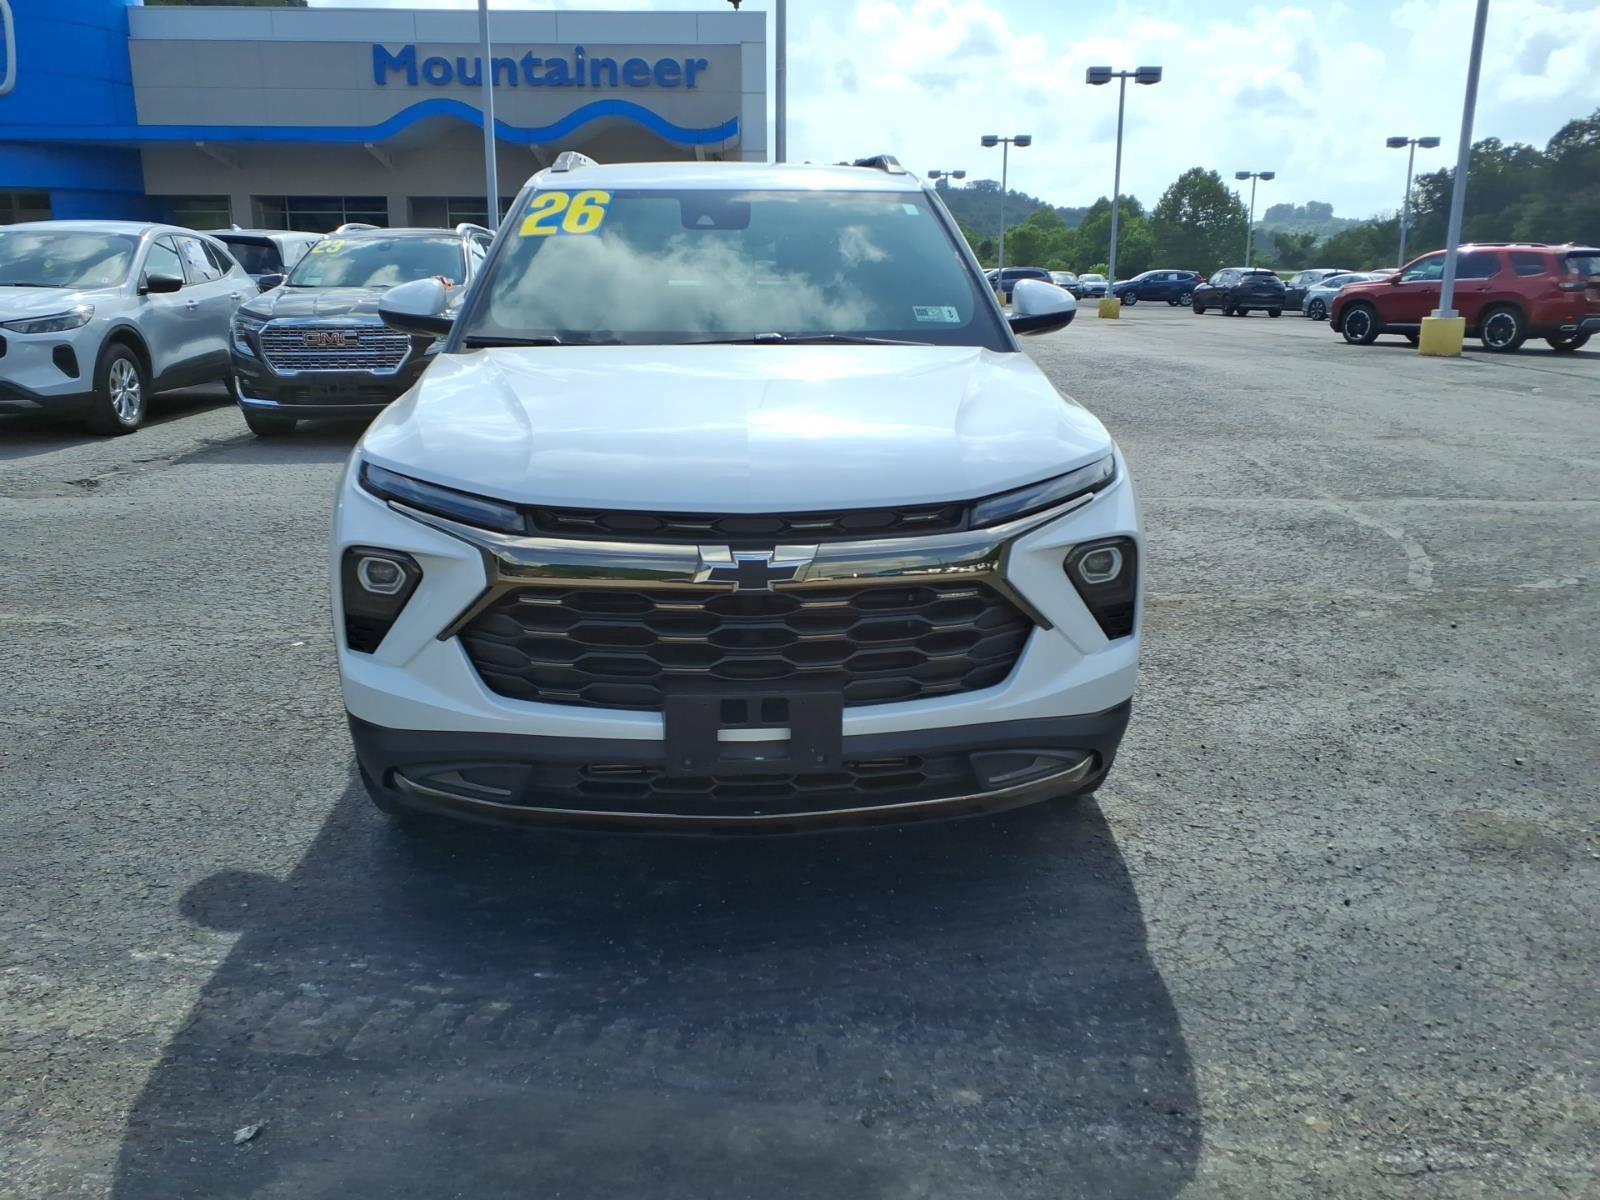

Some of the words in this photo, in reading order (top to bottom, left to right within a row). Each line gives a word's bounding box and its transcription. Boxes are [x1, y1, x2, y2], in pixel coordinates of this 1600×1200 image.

[372, 43, 709, 88] Mountaineer
[518, 190, 611, 236] 26
[303, 331, 359, 346] GMC
